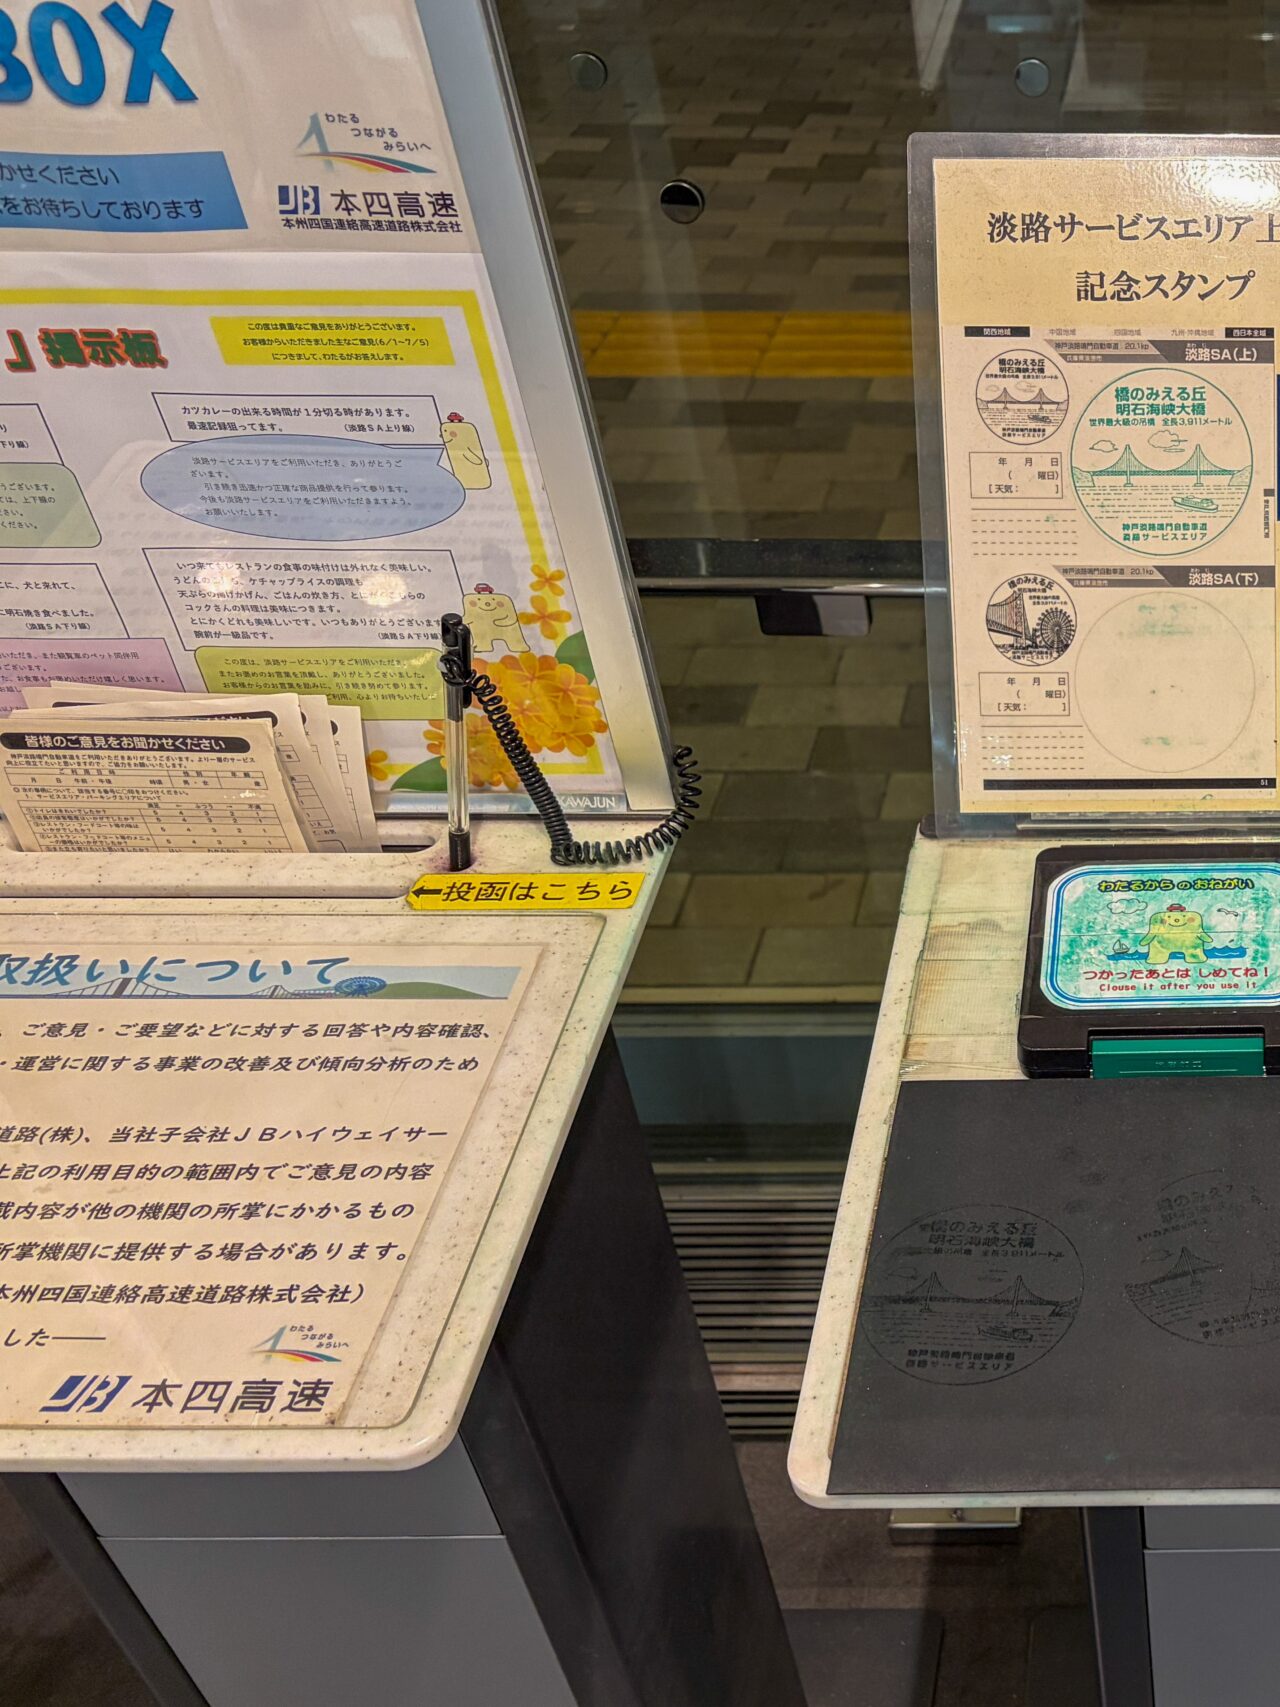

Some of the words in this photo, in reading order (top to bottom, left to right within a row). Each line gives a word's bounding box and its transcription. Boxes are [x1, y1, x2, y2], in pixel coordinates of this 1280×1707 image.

[325, 113, 360, 123] わたる
[350, 127, 399, 138] つながる
[383, 141, 432, 152] みらいへ
[0, 197, 204, 220] をお待ちしております
[330, 189, 459, 218] 本四高速
[283, 217, 463, 233] 本州四国連絡高速道路株式会社
[1075, 270, 1257, 302] 記念スタンプ
[1115, 386, 1207, 402] 橋のみえる丘
[1115, 403, 1206, 416] 明石海峡大橋
[0, 651, 139, 660] いただき、また観覧車のペット同伴用
[24, 734, 226, 751] 皆様のご意見をお聞かせください
[441, 881, 634, 903] 投函はこちら
[0, 952, 350, 986] 取扱いについて
[1082, 968, 1191, 981] つかったあとは
[1160, 982, 1191, 991] after
[1197, 983, 1215, 992] you
[131, 1378, 334, 1414] 本四高速
